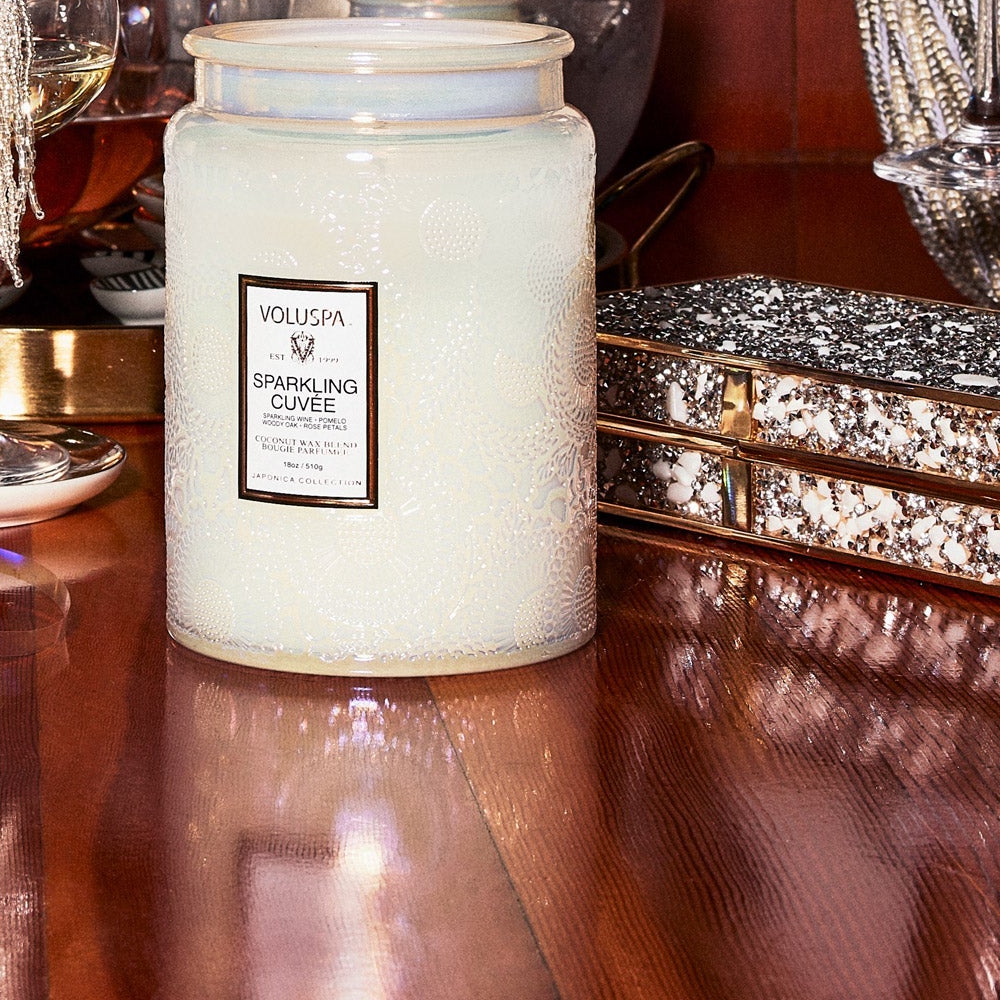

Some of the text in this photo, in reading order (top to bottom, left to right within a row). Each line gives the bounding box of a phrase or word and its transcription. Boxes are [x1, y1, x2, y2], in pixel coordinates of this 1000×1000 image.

[260, 305, 345, 326] VOLUSPA
[253, 373, 357, 394] SPARKLING
[271, 394, 336, 412] CUVÉE
[262, 419, 284, 427] WOODY
[263, 413, 295, 421] SPARKLING
[318, 417, 347, 425] POMELO
[255, 434, 297, 446] COCONUT
[299, 440, 321, 448] WAX
[262, 443, 294, 453] BOUGIE
[283, 461, 299, 469] 18oz
[305, 463, 323, 471] 510g
[252, 473, 295, 483] JAPONICA
